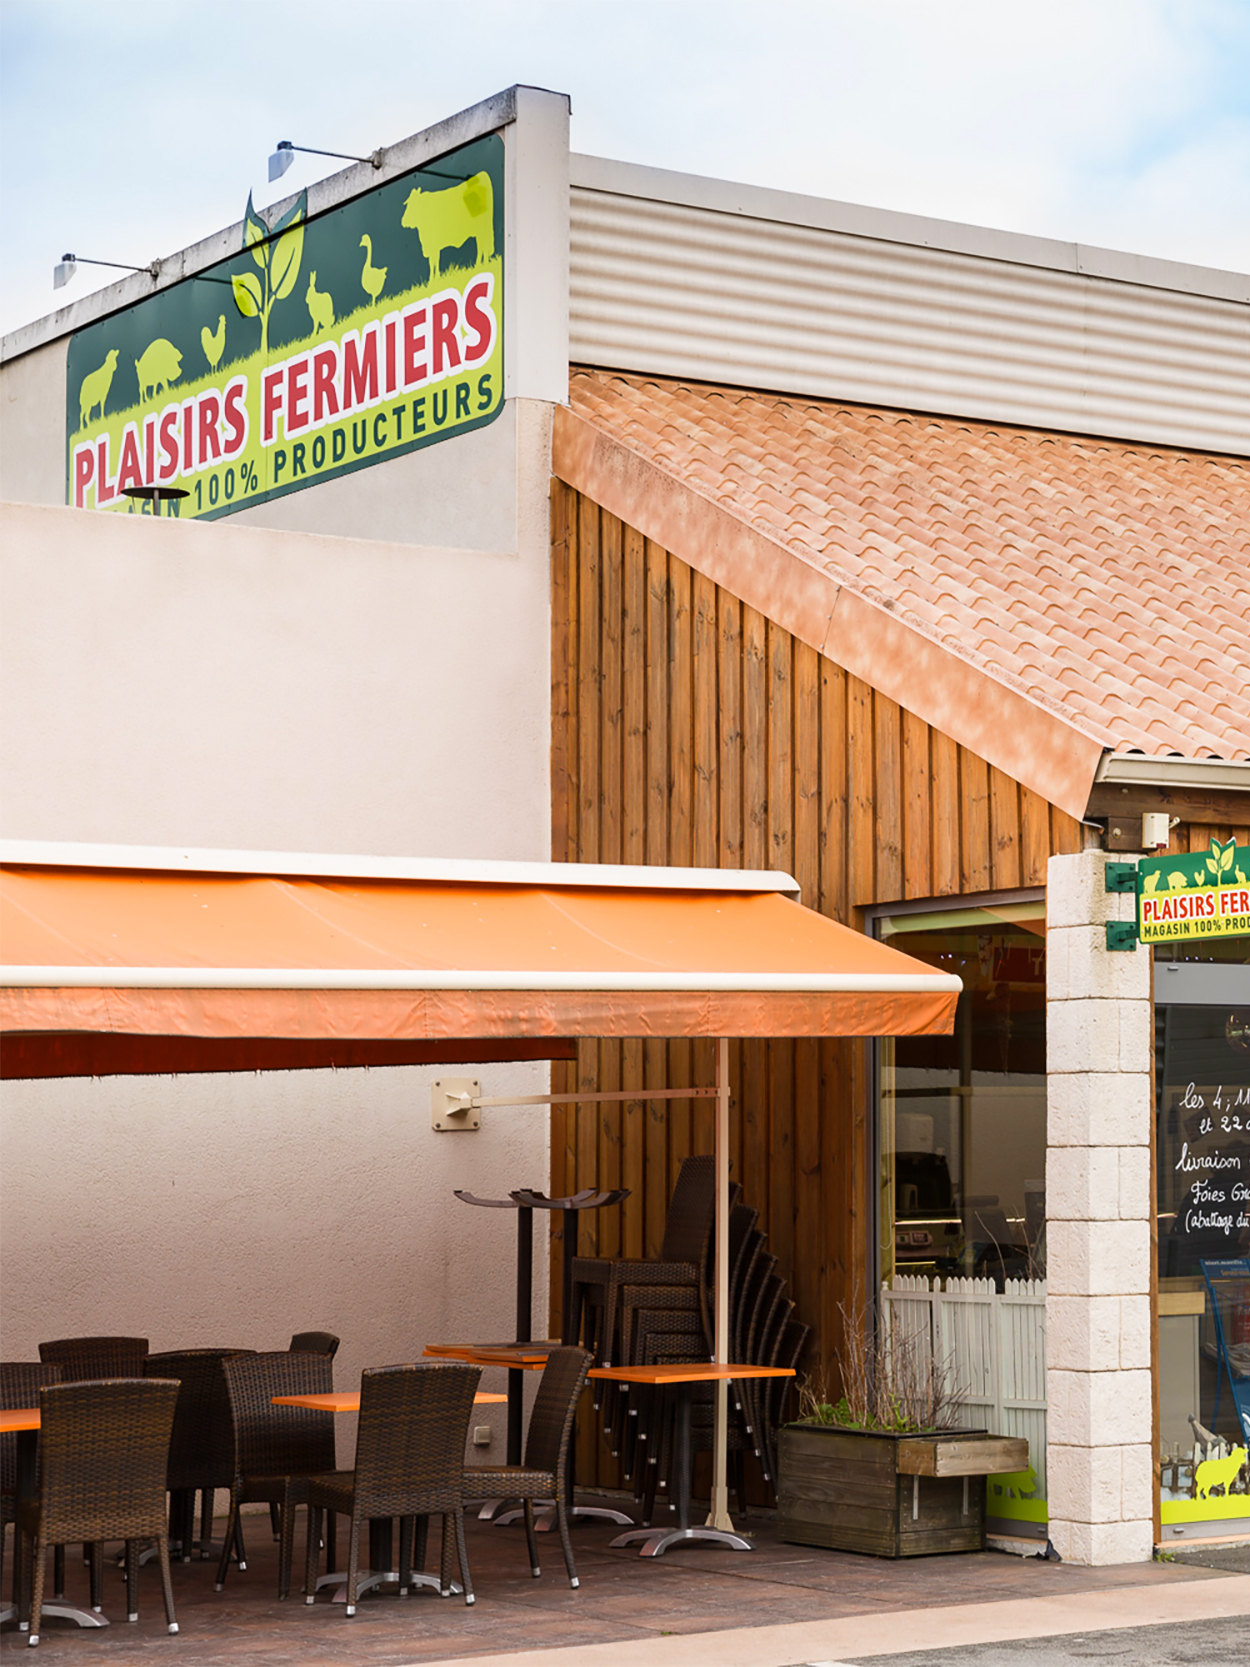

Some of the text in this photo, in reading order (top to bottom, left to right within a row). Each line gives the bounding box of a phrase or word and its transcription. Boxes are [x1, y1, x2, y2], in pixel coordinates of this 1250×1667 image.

[75, 281, 492, 508] PLAISIRS FERMIERS
[194, 373, 494, 510] 100% PRODUCTEURS
[1143, 893, 1215, 922] PLAISIRS
[1144, 922, 1190, 938] MAGASIN
[1194, 919, 1222, 933] 100%
[1199, 1117, 1214, 1134] et
[1220, 1115, 1243, 1133] 22
[1190, 1179, 1226, 1205] Foies
[1235, 1211, 1250, 1228] du
